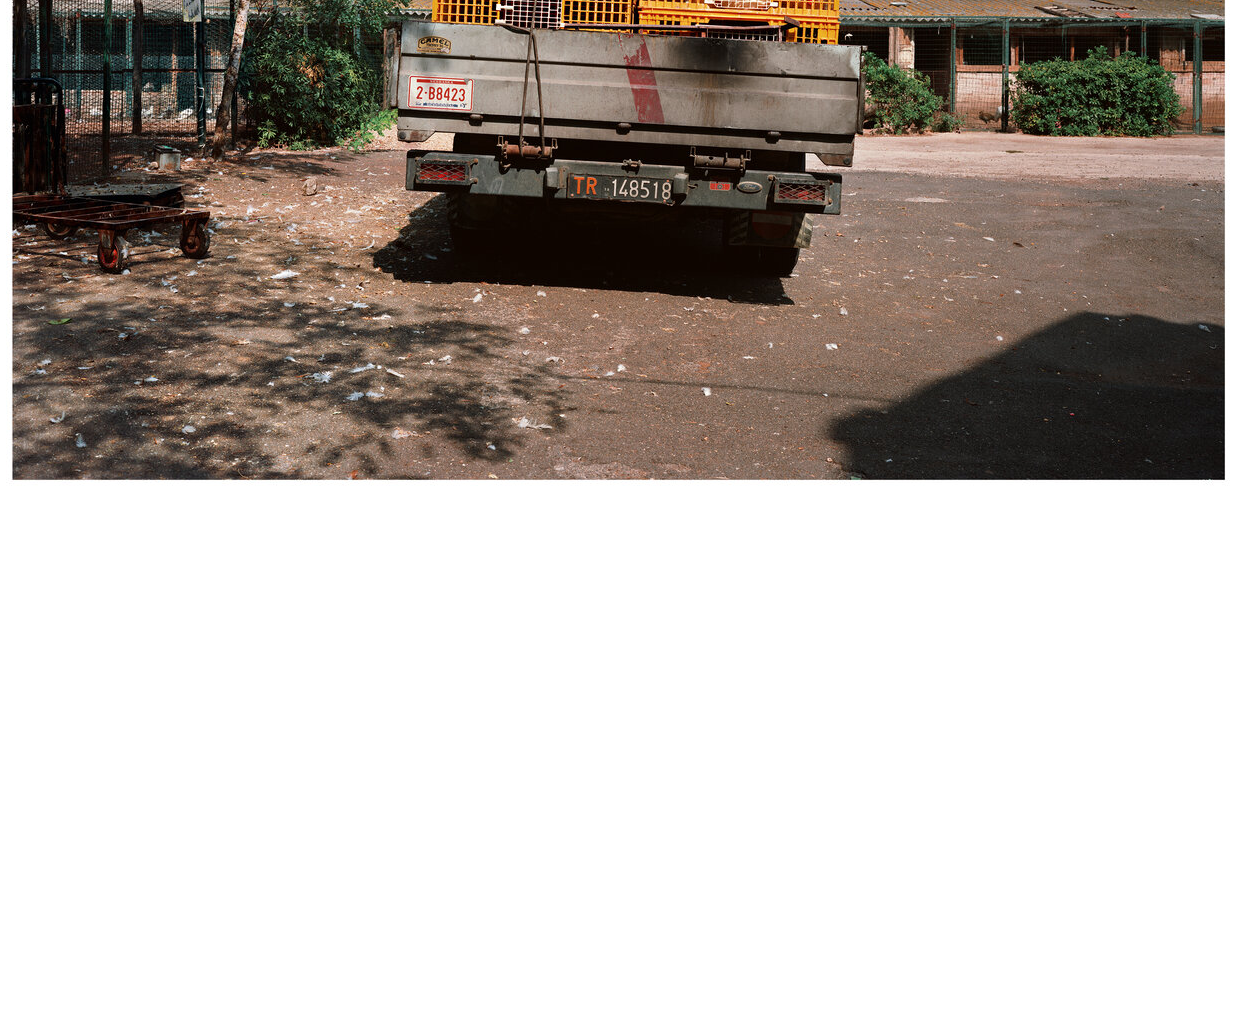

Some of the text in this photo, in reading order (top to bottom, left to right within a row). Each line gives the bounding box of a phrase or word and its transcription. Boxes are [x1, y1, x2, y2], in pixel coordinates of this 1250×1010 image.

[420, 37, 449, 46] CAMEL
[573, 176, 672, 200] TR 148518
